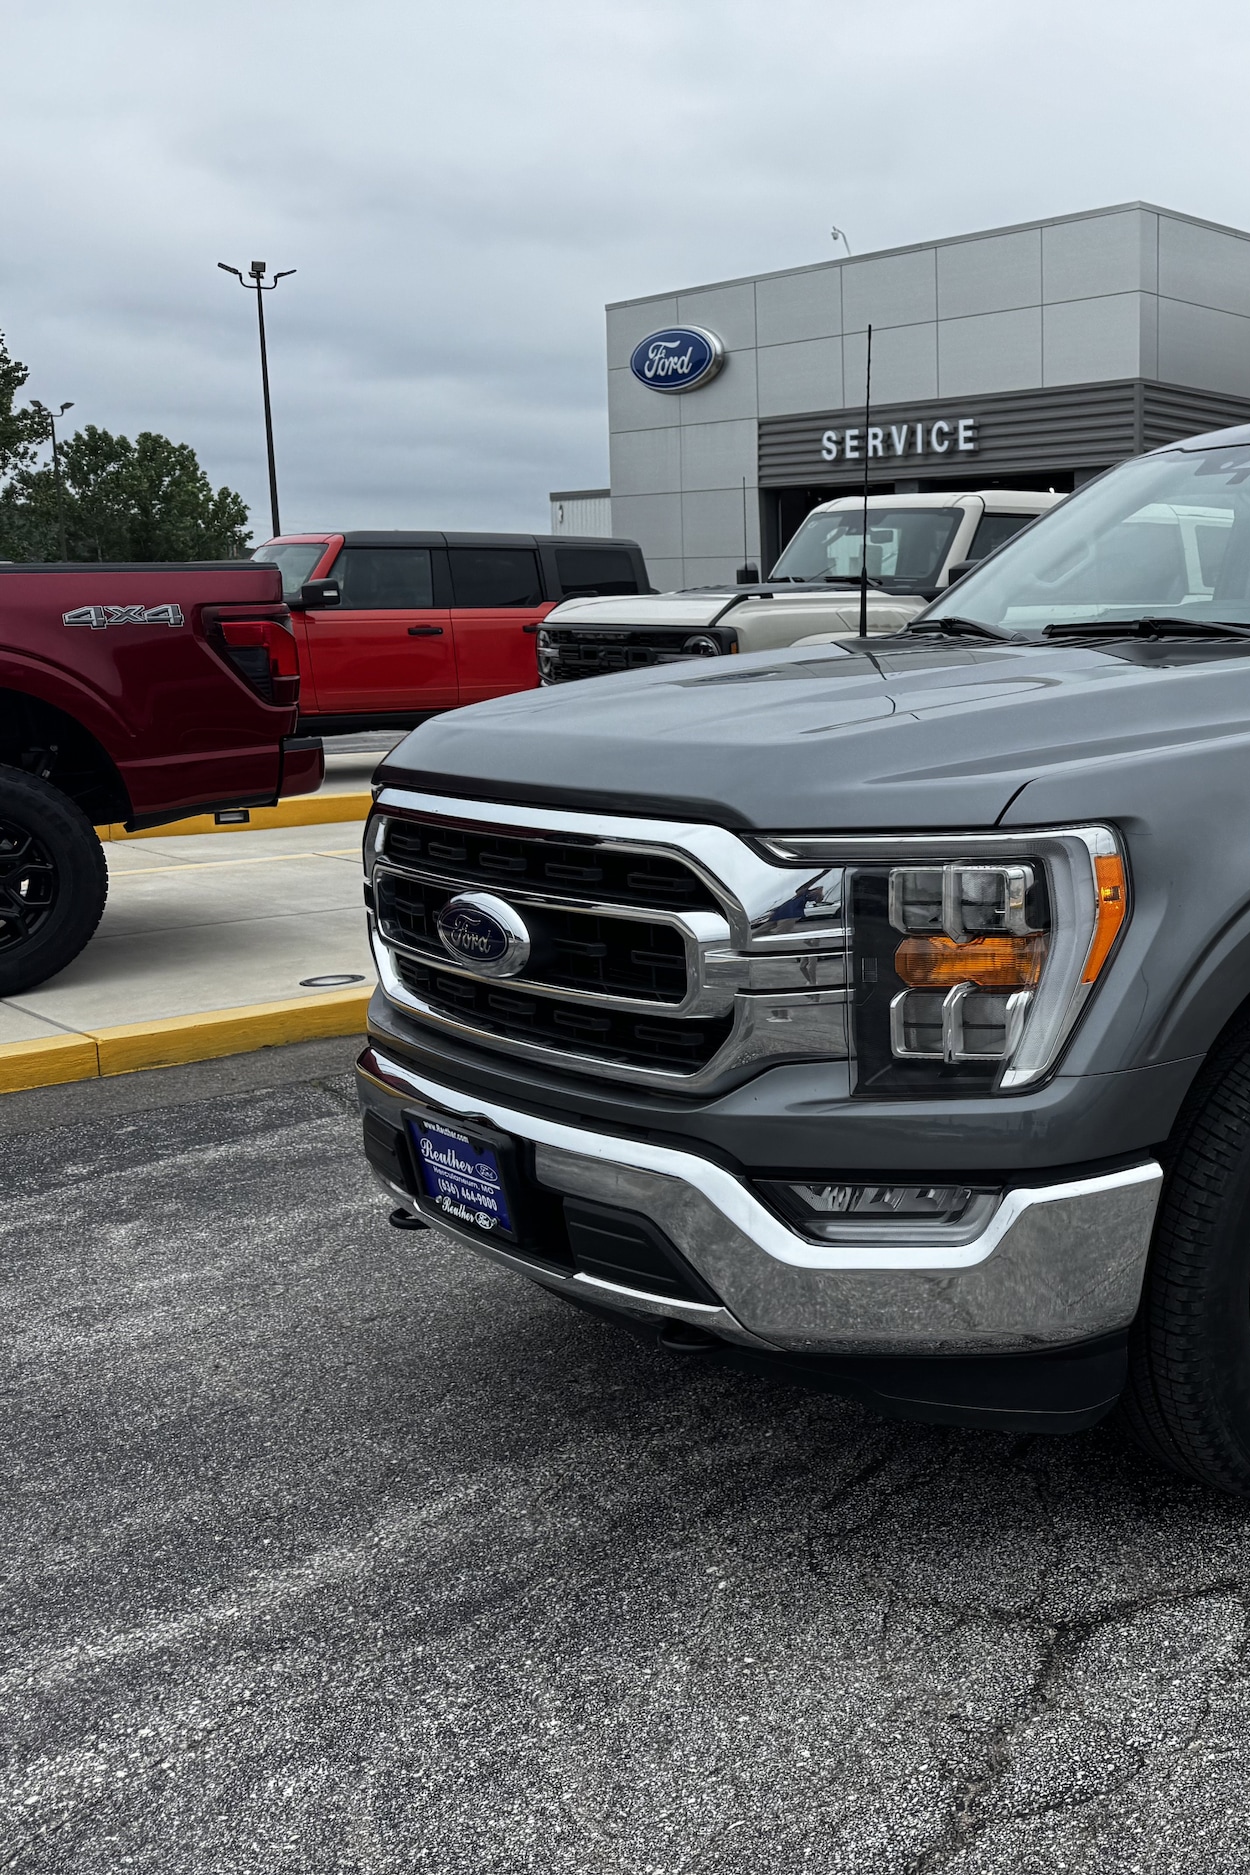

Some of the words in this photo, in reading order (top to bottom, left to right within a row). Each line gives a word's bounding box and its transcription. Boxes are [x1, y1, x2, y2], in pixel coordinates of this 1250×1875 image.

[644, 340, 693, 378] Ford
[821, 418, 975, 461] SERVICE
[451, 914, 492, 953] Ford
[420, 1138, 474, 1174] Reuther
[438, 1178, 460, 1199] (636)
[461, 1187, 497, 1211] 464-9000
[481, 1184, 494, 1195] MO
[441, 1196, 474, 1223] Reuther
